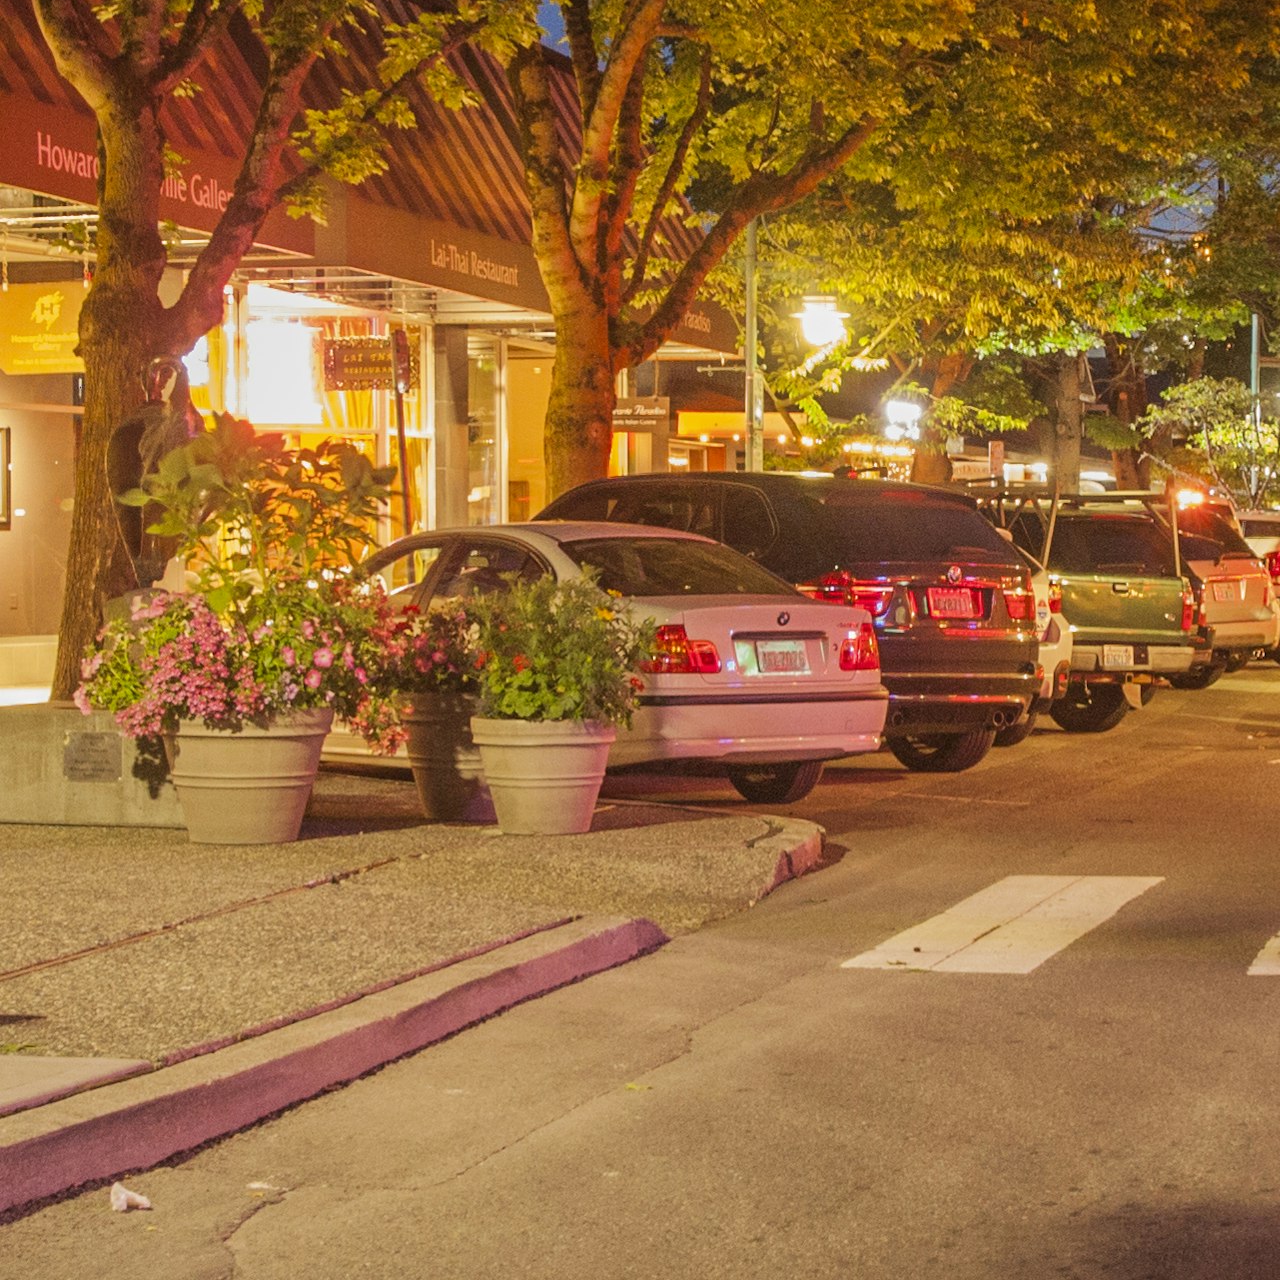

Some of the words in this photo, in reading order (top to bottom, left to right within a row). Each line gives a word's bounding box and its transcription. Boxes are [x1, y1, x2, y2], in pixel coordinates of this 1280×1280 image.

[190, 174, 234, 212] Galler
[430, 239, 469, 275] Lai-Thai
[470, 251, 519, 287] Restaurant
